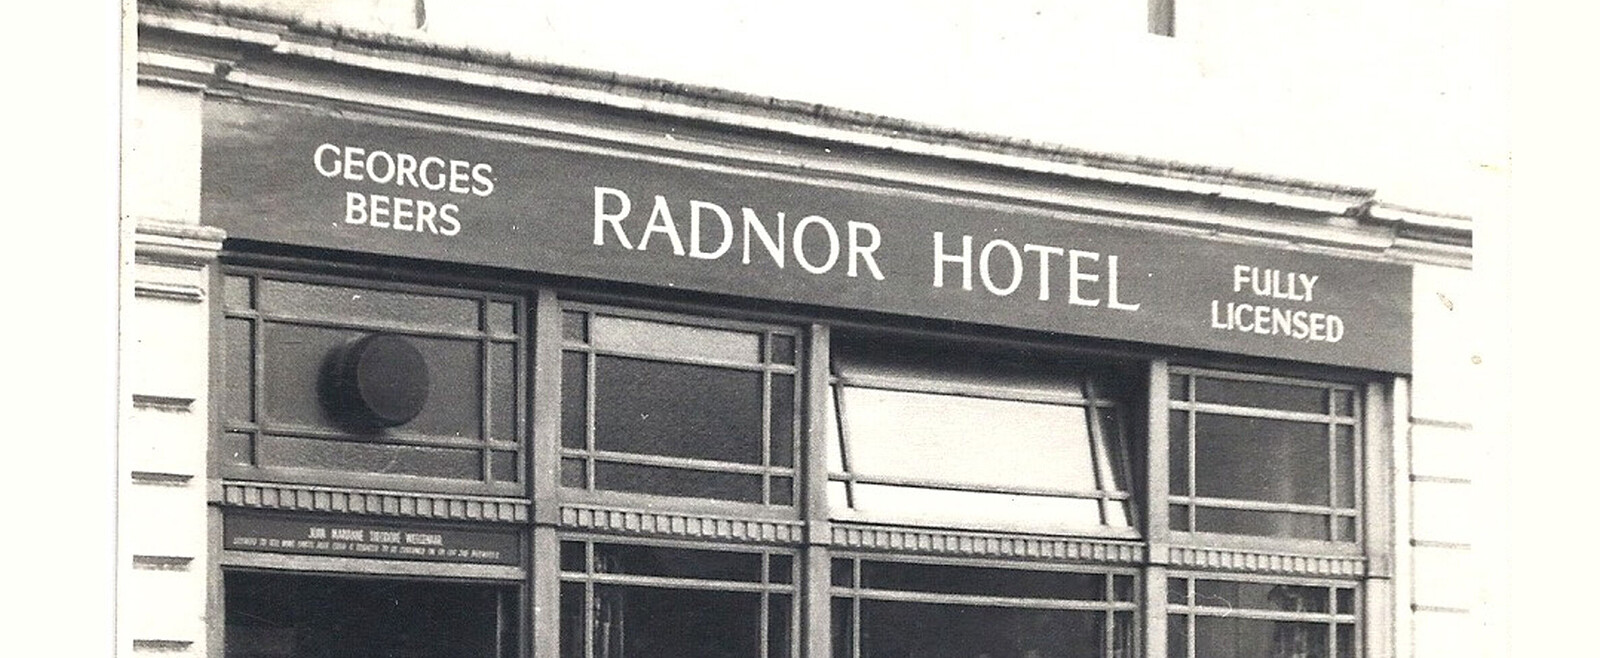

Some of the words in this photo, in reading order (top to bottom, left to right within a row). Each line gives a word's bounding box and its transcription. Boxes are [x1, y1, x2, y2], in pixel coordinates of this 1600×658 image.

[313, 142, 495, 197] GEORGES
[344, 191, 462, 237] BEERS
[592, 185, 886, 281] RADNOR
[932, 231, 1141, 313] HOTEL
[1232, 263, 1320, 302] FULLY
[1210, 300, 1345, 345] LICENSED
